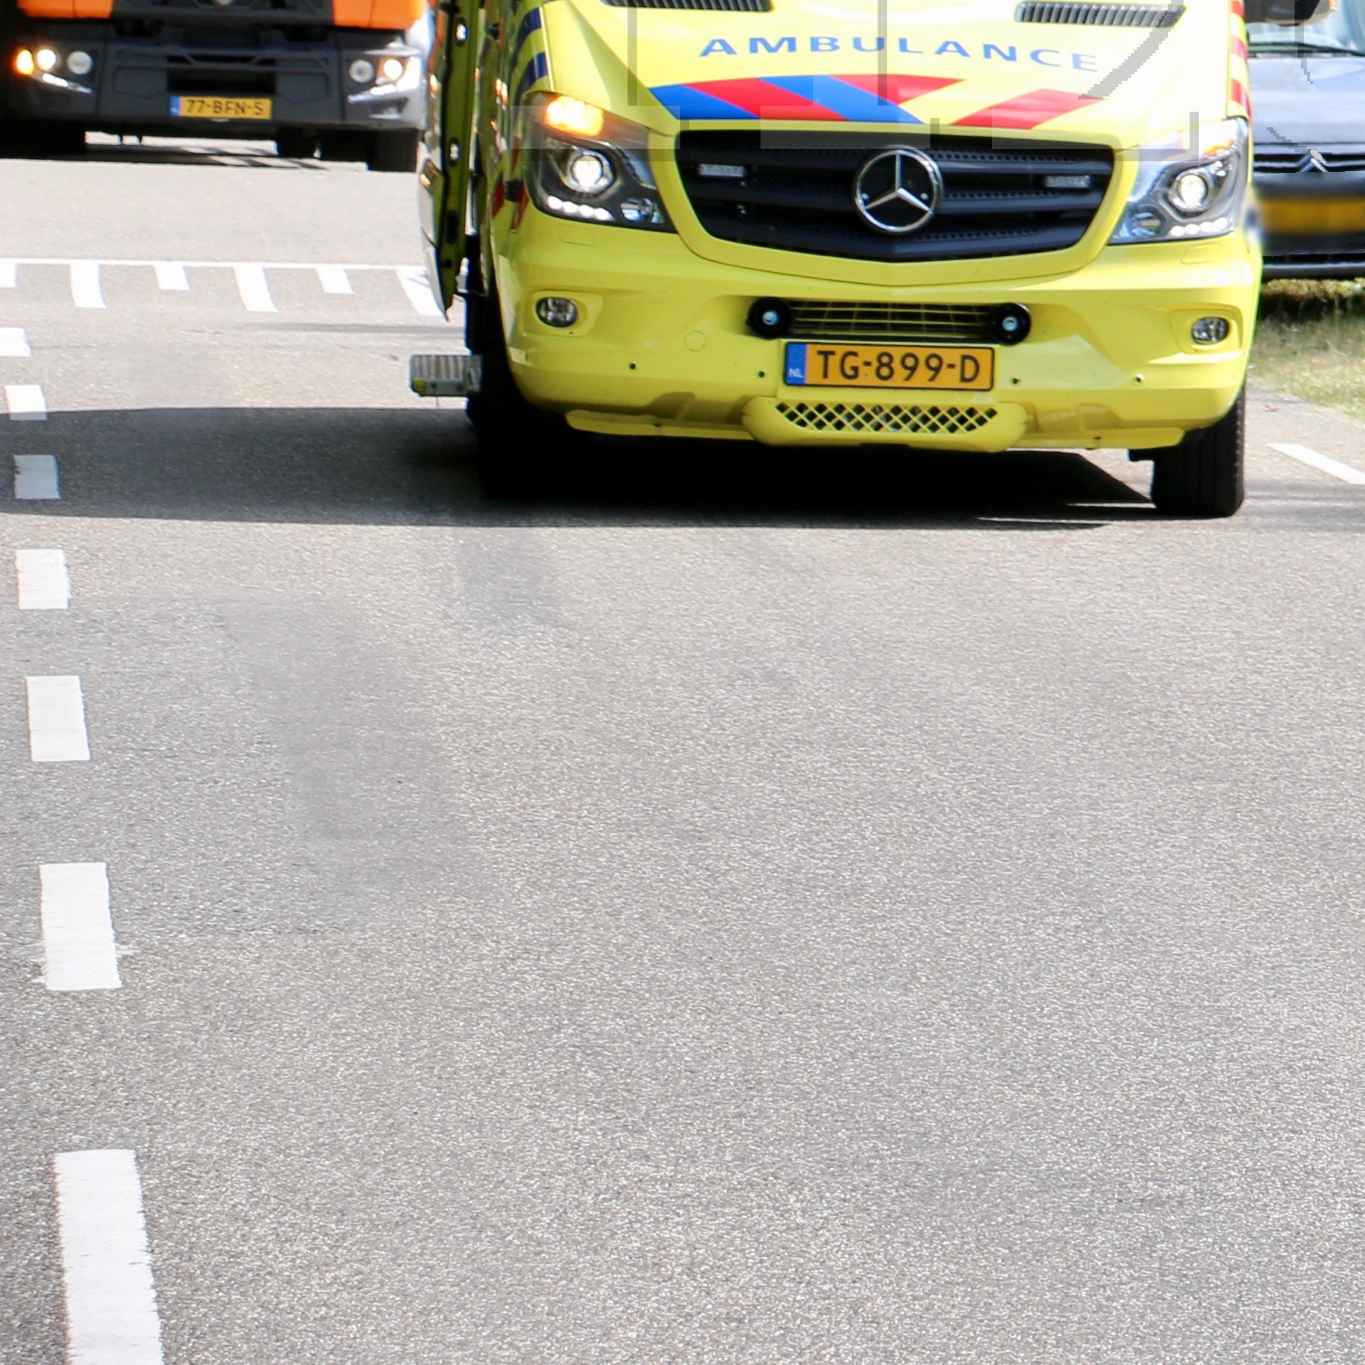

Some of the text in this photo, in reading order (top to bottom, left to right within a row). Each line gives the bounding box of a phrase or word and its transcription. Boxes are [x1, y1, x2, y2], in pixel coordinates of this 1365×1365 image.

[697, 36, 1099, 73] AMBULANCE
[788, 349, 980, 383] NL TG-899-D
